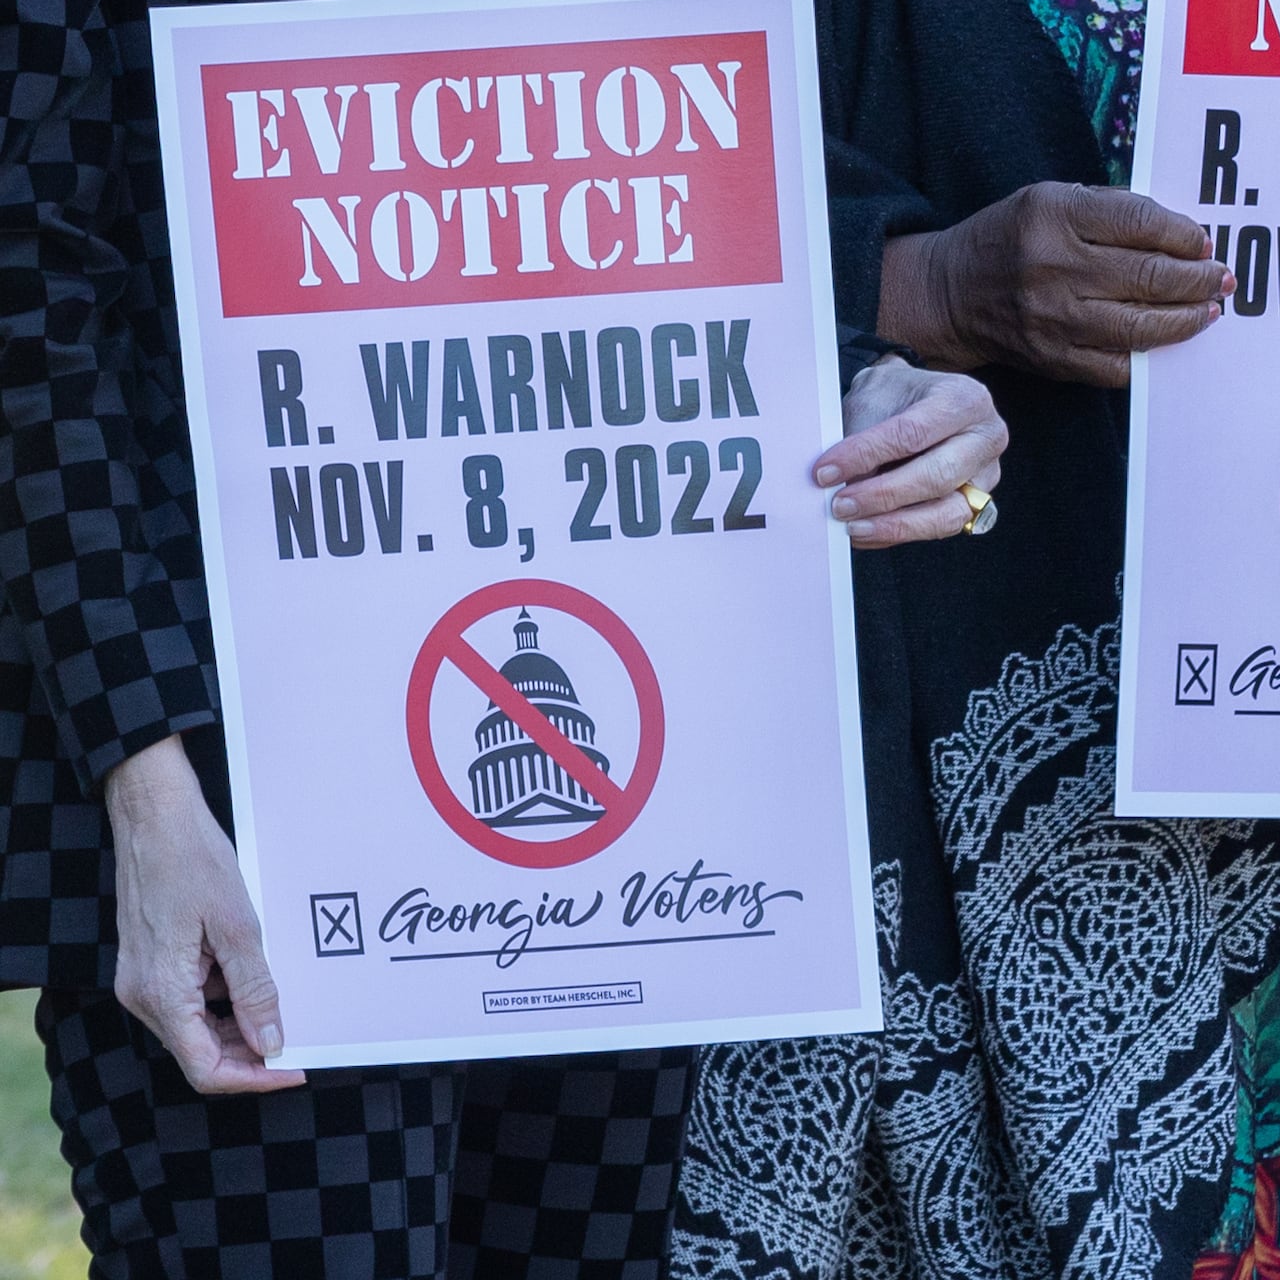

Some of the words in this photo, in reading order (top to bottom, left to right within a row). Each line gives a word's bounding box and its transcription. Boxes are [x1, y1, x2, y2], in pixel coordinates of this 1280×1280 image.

[225, 60, 743, 181] EVICTION
[1198, 108, 1259, 206] R.
[291, 174, 695, 287] NOTICE
[257, 348, 335, 448] R.
[359, 319, 760, 442] WARNOCK
[269, 459, 434, 562] NOV.
[463, 453, 536, 563] 8,
[564, 437, 767, 542] 2022
[378, 882, 603, 969] Georgia
[619, 859, 804, 930] Voters
[489, 998, 510, 1008] PAID
[511, 996, 529, 1006] FOR
[531, 995, 542, 1005] BY
[543, 993, 567, 1004] TEAM
[568, 990, 617, 1003] HERSCHEL,
[617, 988, 637, 999] INC.
